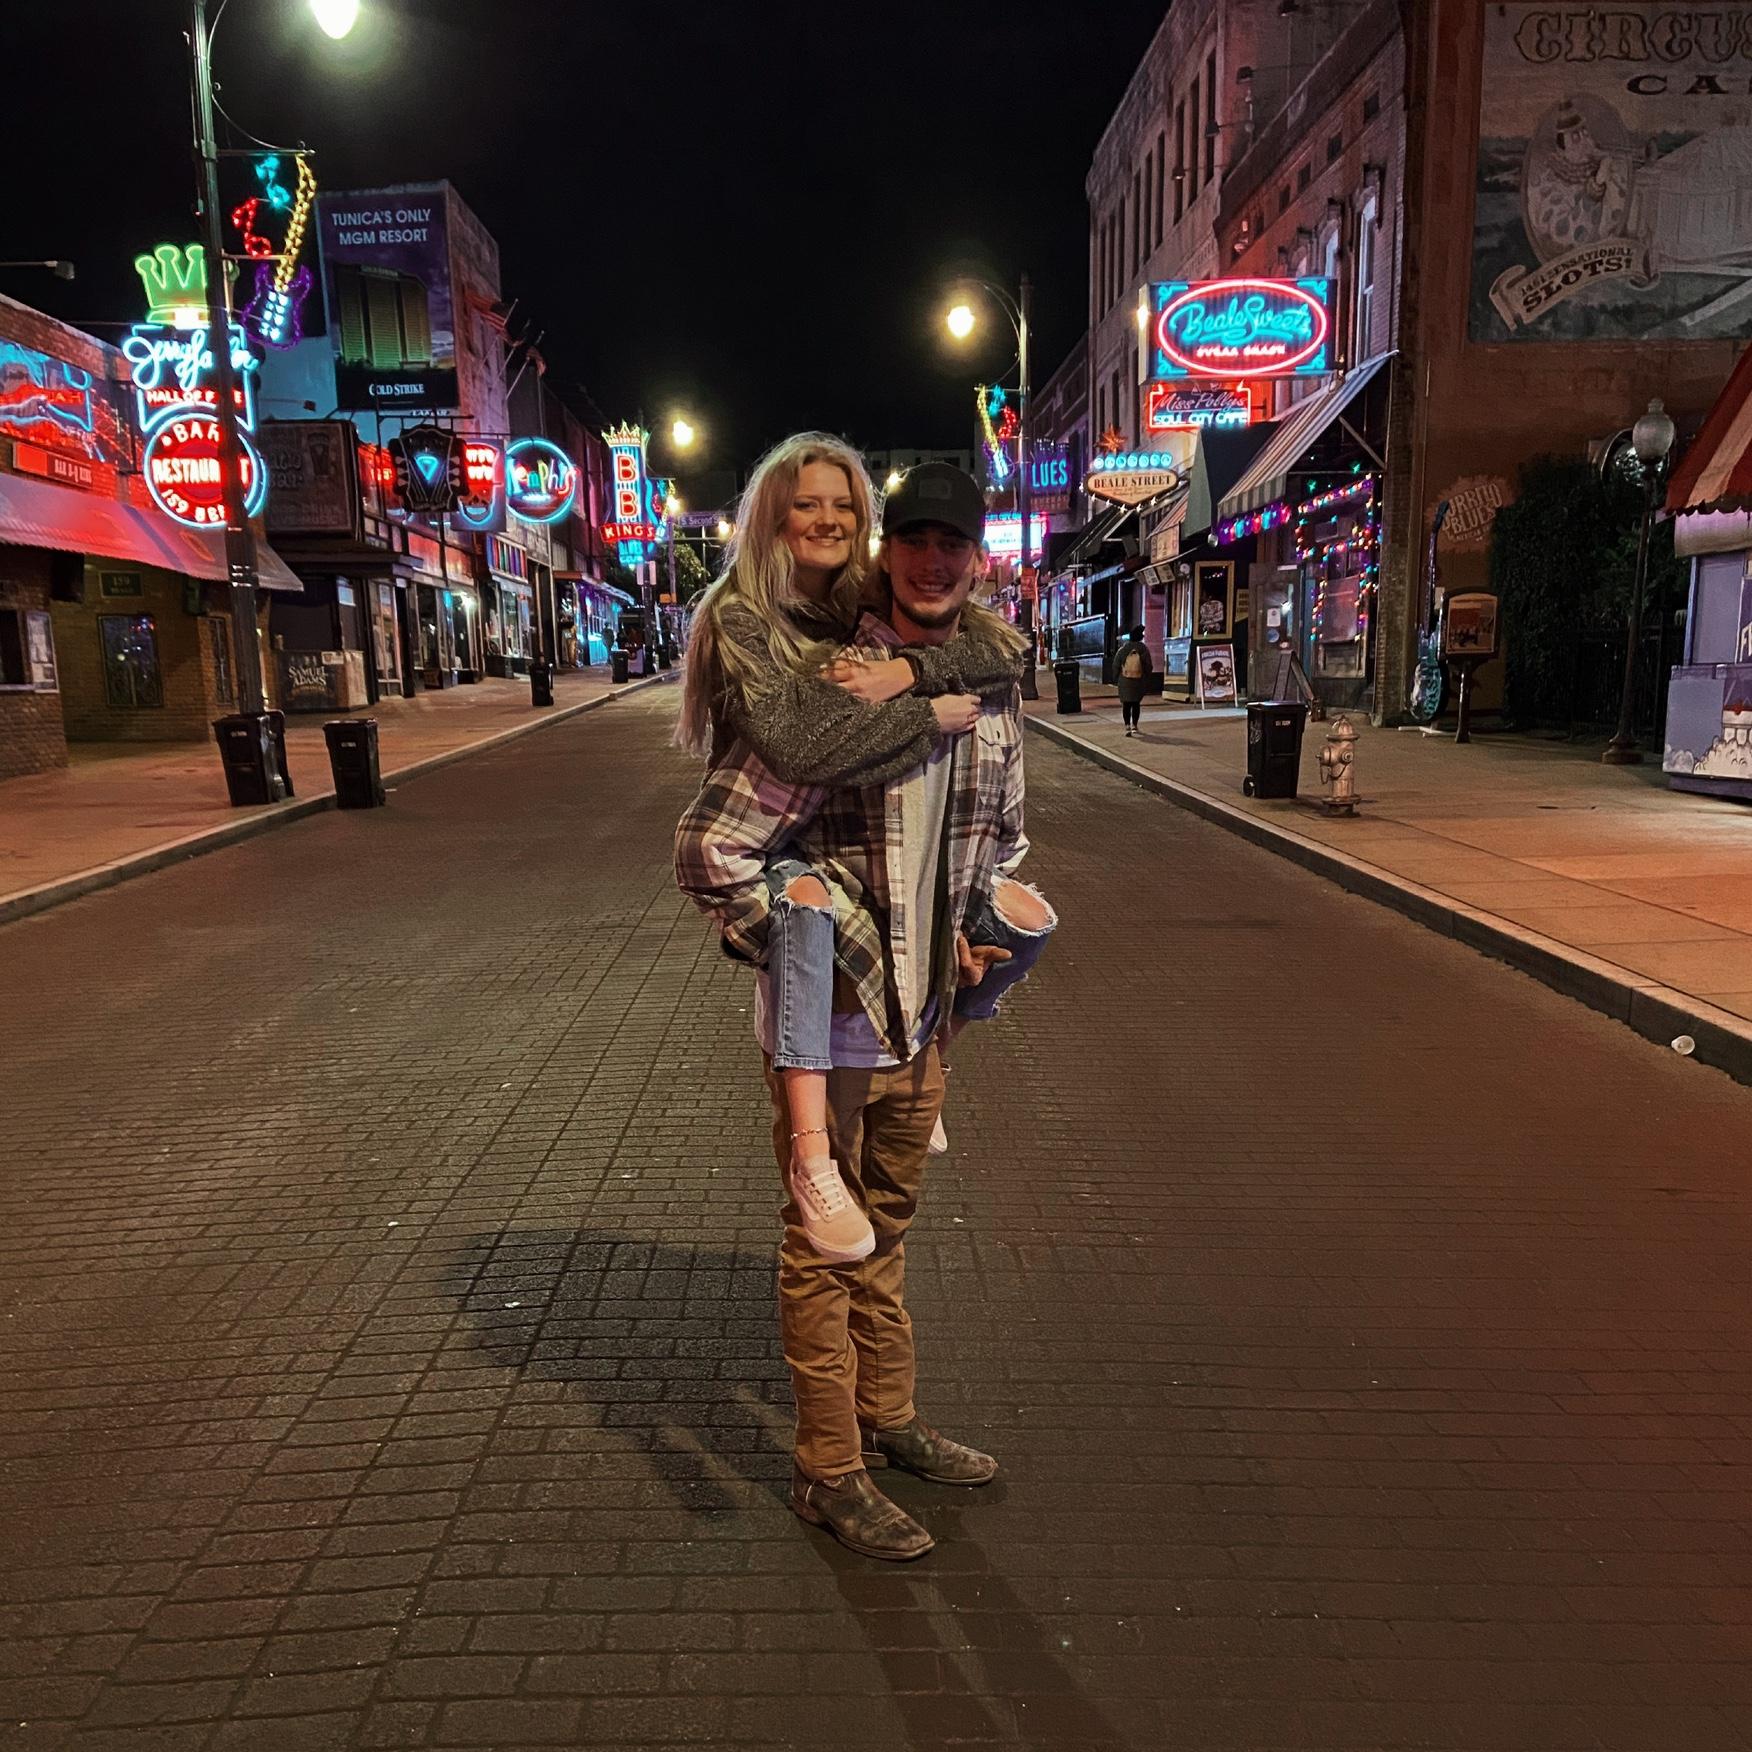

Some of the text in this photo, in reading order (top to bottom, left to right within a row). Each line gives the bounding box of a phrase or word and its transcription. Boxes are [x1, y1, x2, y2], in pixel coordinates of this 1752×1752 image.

[1515, 10, 1752, 63] CIRCU
[332, 209, 431, 227] TUNICA'S ONLY
[339, 229, 428, 246] MGM RESORT
[1523, 257, 1633, 313] SLOTS!
[146, 389, 182, 404] HALL
[205, 390, 243, 404] FE
[394, 383, 425, 394] STRIKE
[1153, 393, 1194, 412] Miss
[1154, 414, 1187, 424] SOUL
[151, 458, 251, 485] RESTAURT
[617, 456, 636, 481] B
[1031, 459, 1069, 488] LUES
[1094, 477, 1128, 489] BEALE
[1131, 474, 1171, 486] STREET
[161, 488, 189, 513] 159
[620, 491, 638, 516] B
[604, 525, 654, 539] KINGS
